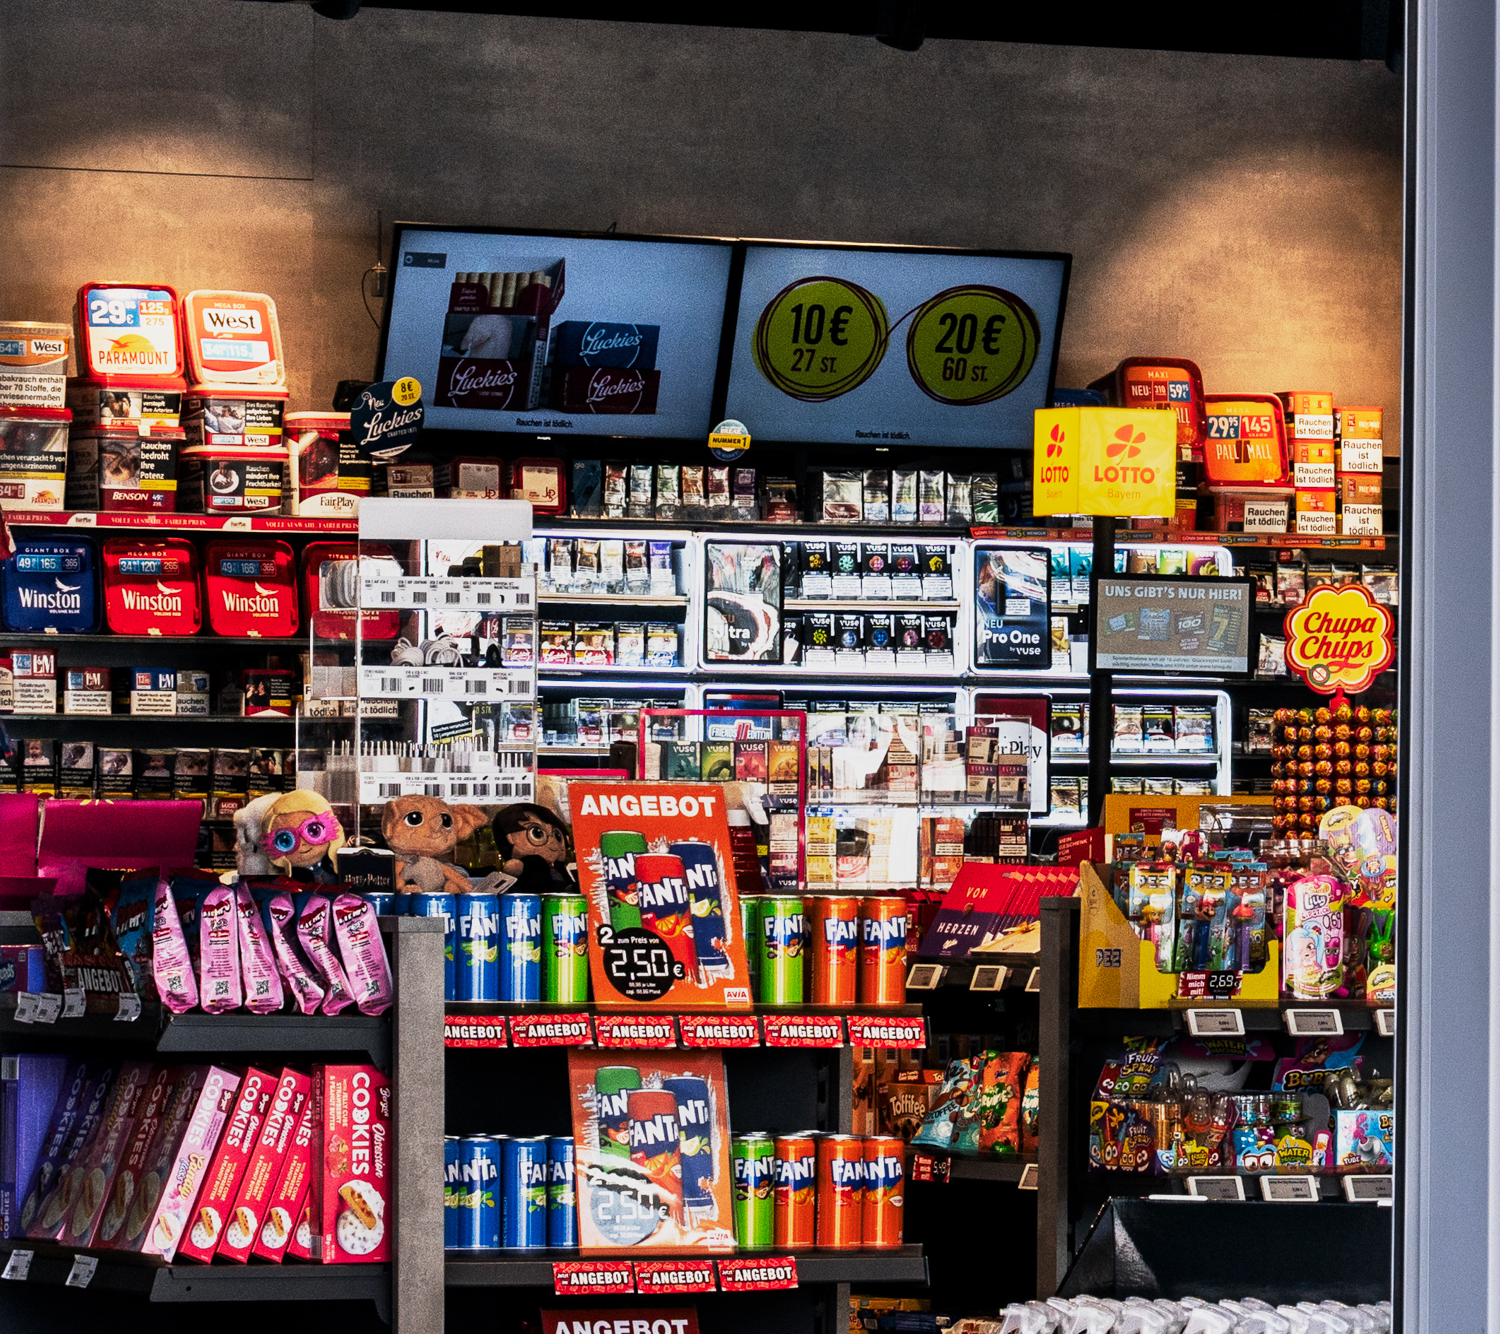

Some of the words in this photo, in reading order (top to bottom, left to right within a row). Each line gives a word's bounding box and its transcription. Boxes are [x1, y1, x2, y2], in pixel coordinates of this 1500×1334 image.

[208, 313, 257, 330] West
[790, 302, 826, 346] 10
[828, 305, 854, 347] €
[935, 312, 978, 355] 20
[981, 314, 1006, 356] €
[99, 350, 169, 365] PARAMOUNT
[790, 348, 815, 372] 27
[821, 356, 837, 373] ST.
[942, 357, 967, 382] 60
[970, 364, 988, 382] ST.
[448, 365, 517, 397] Luckies
[361, 408, 423, 447] Luckies
[1242, 417, 1271, 434] 145
[141, 441, 172, 451] Rauchen
[712, 436, 742, 446] NUMMER
[141, 452, 170, 461] bedroht
[1216, 443, 1239, 461] PALL
[1247, 443, 1273, 461] MALL
[141, 461, 156, 470] Ihre
[141, 470, 165, 480] Potenz
[1093, 465, 1155, 484] LOTTO
[112, 491, 149, 501] BENSON
[1107, 488, 1141, 500] Bayern
[1247, 508, 1285, 518] Rauchen
[1245, 517, 1255, 527] ist
[1257, 516, 1286, 527] tödlich
[18, 586, 81, 610] Winston
[122, 587, 182, 612] Winston
[1105, 585, 1132, 598] UNS
[1178, 587, 1206, 600] NUR
[1208, 587, 1243, 601] HIER!
[1303, 611, 1377, 634] Chupa
[982, 631, 1008, 645] Pro
[1009, 630, 1040, 644] One
[1300, 635, 1373, 660] Chups
[581, 794, 716, 818] ANGEBOT
[965, 887, 988, 899] VON
[600, 927, 614, 944] 2
[937, 922, 979, 936] HERZEN
[610, 949, 669, 980] 2,50
[672, 963, 683, 978] €
[726, 990, 747, 999] AVIA
[611, 1024, 671, 1040] ANGEBOT
[570, 1270, 629, 1285] ANGEBOT
